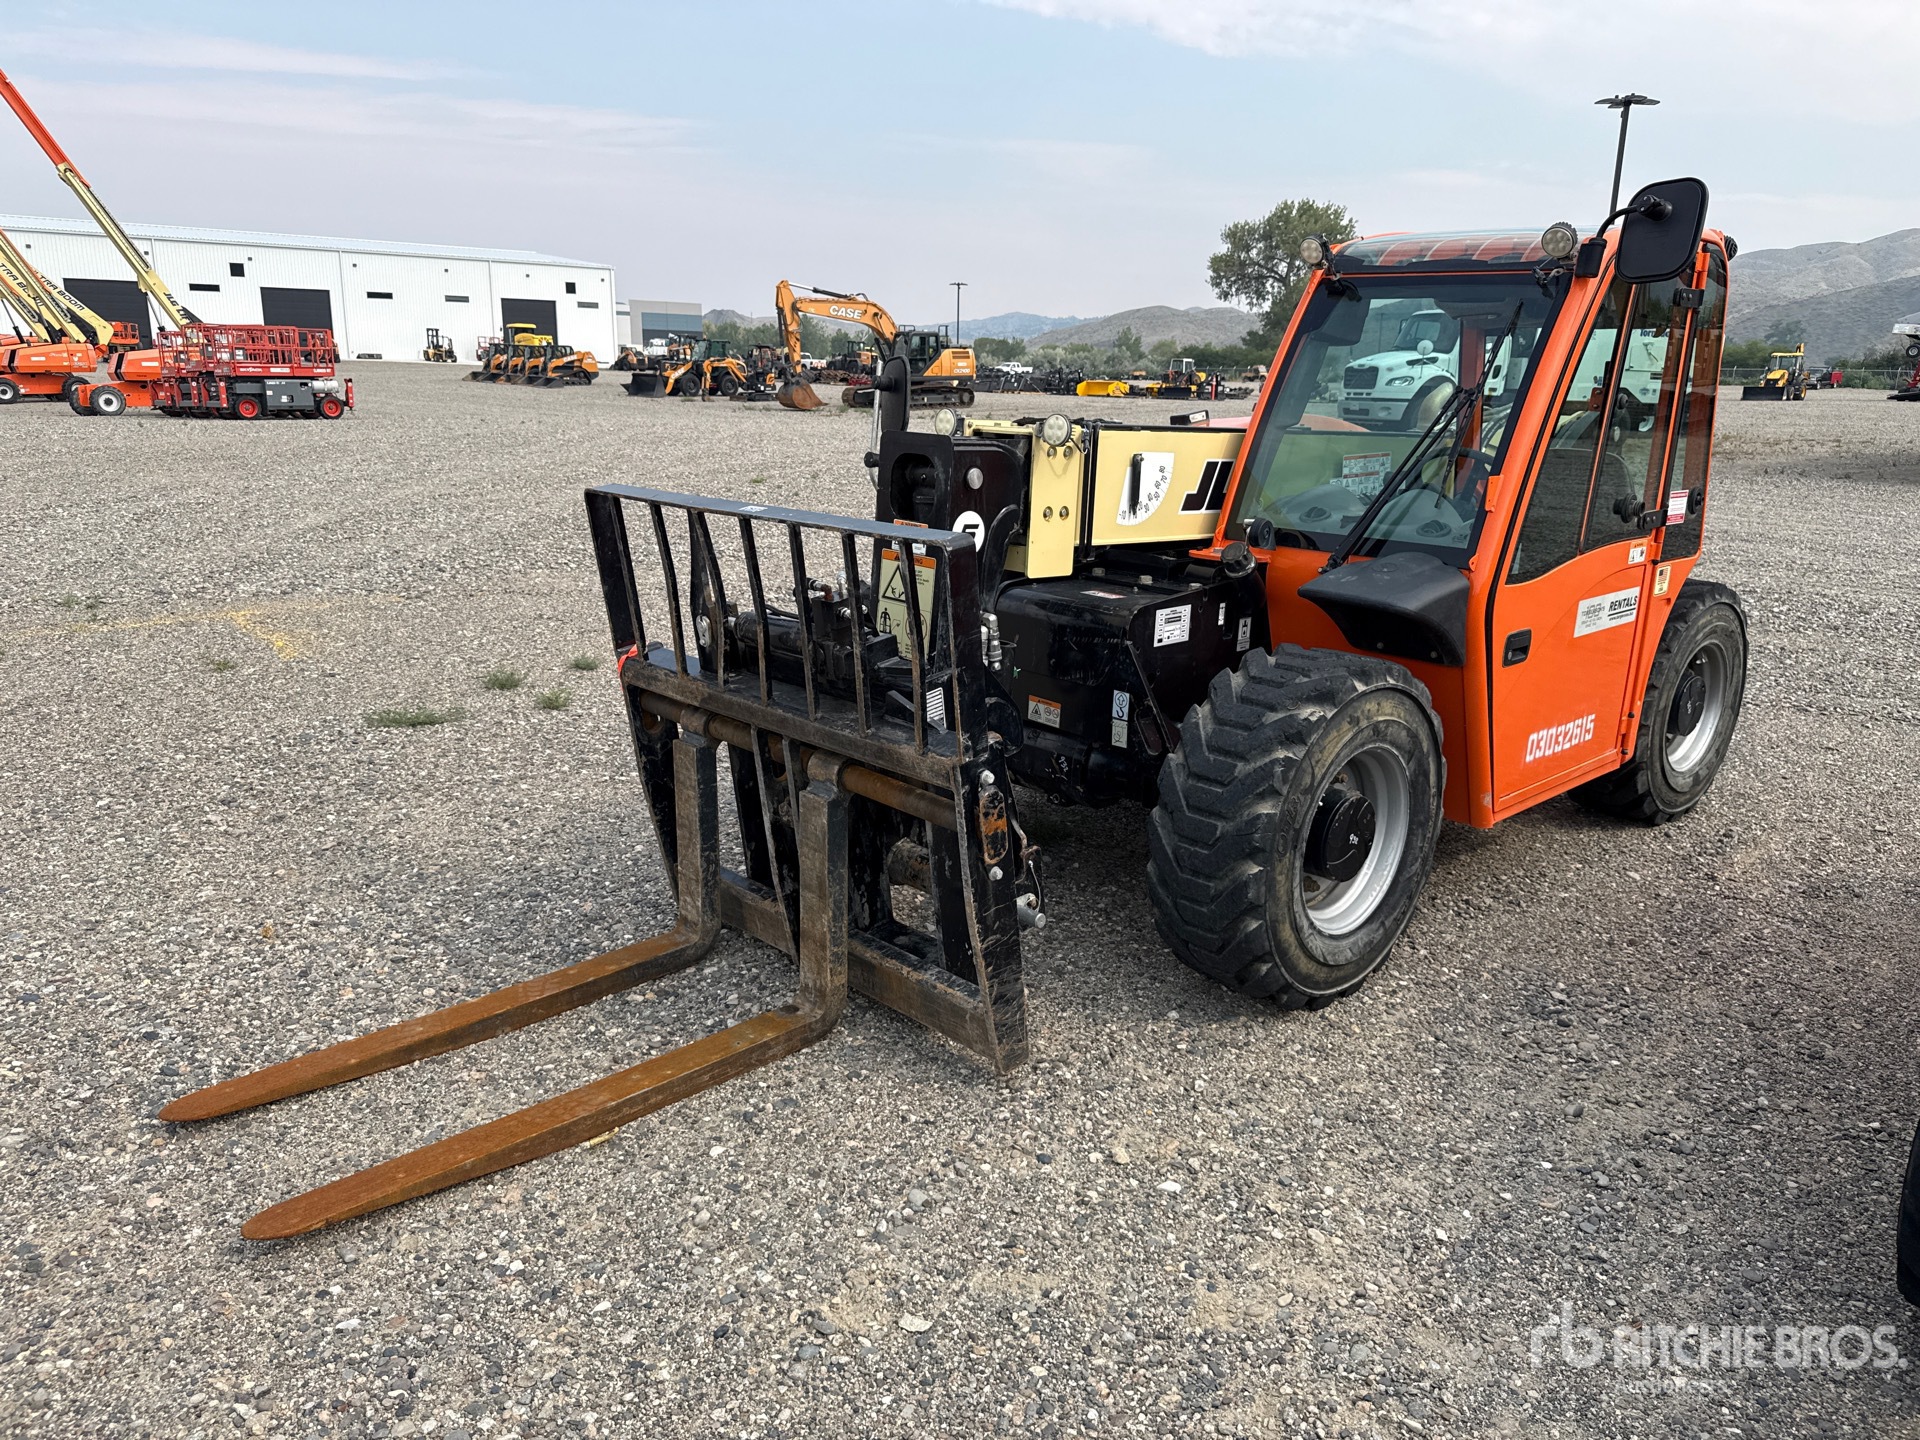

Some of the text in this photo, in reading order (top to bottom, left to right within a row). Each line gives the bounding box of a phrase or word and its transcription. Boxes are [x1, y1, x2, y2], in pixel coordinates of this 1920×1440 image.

[0, 262, 45, 307] TRA BOM
[36, 270, 85, 312] TRA BOOM
[163, 292, 179, 307] JLG
[829, 305, 863, 320] CASE
[1178, 459, 1235, 515] JL
[1608, 595, 1638, 613] RENTALS
[1525, 713, 1595, 763] 03032615
